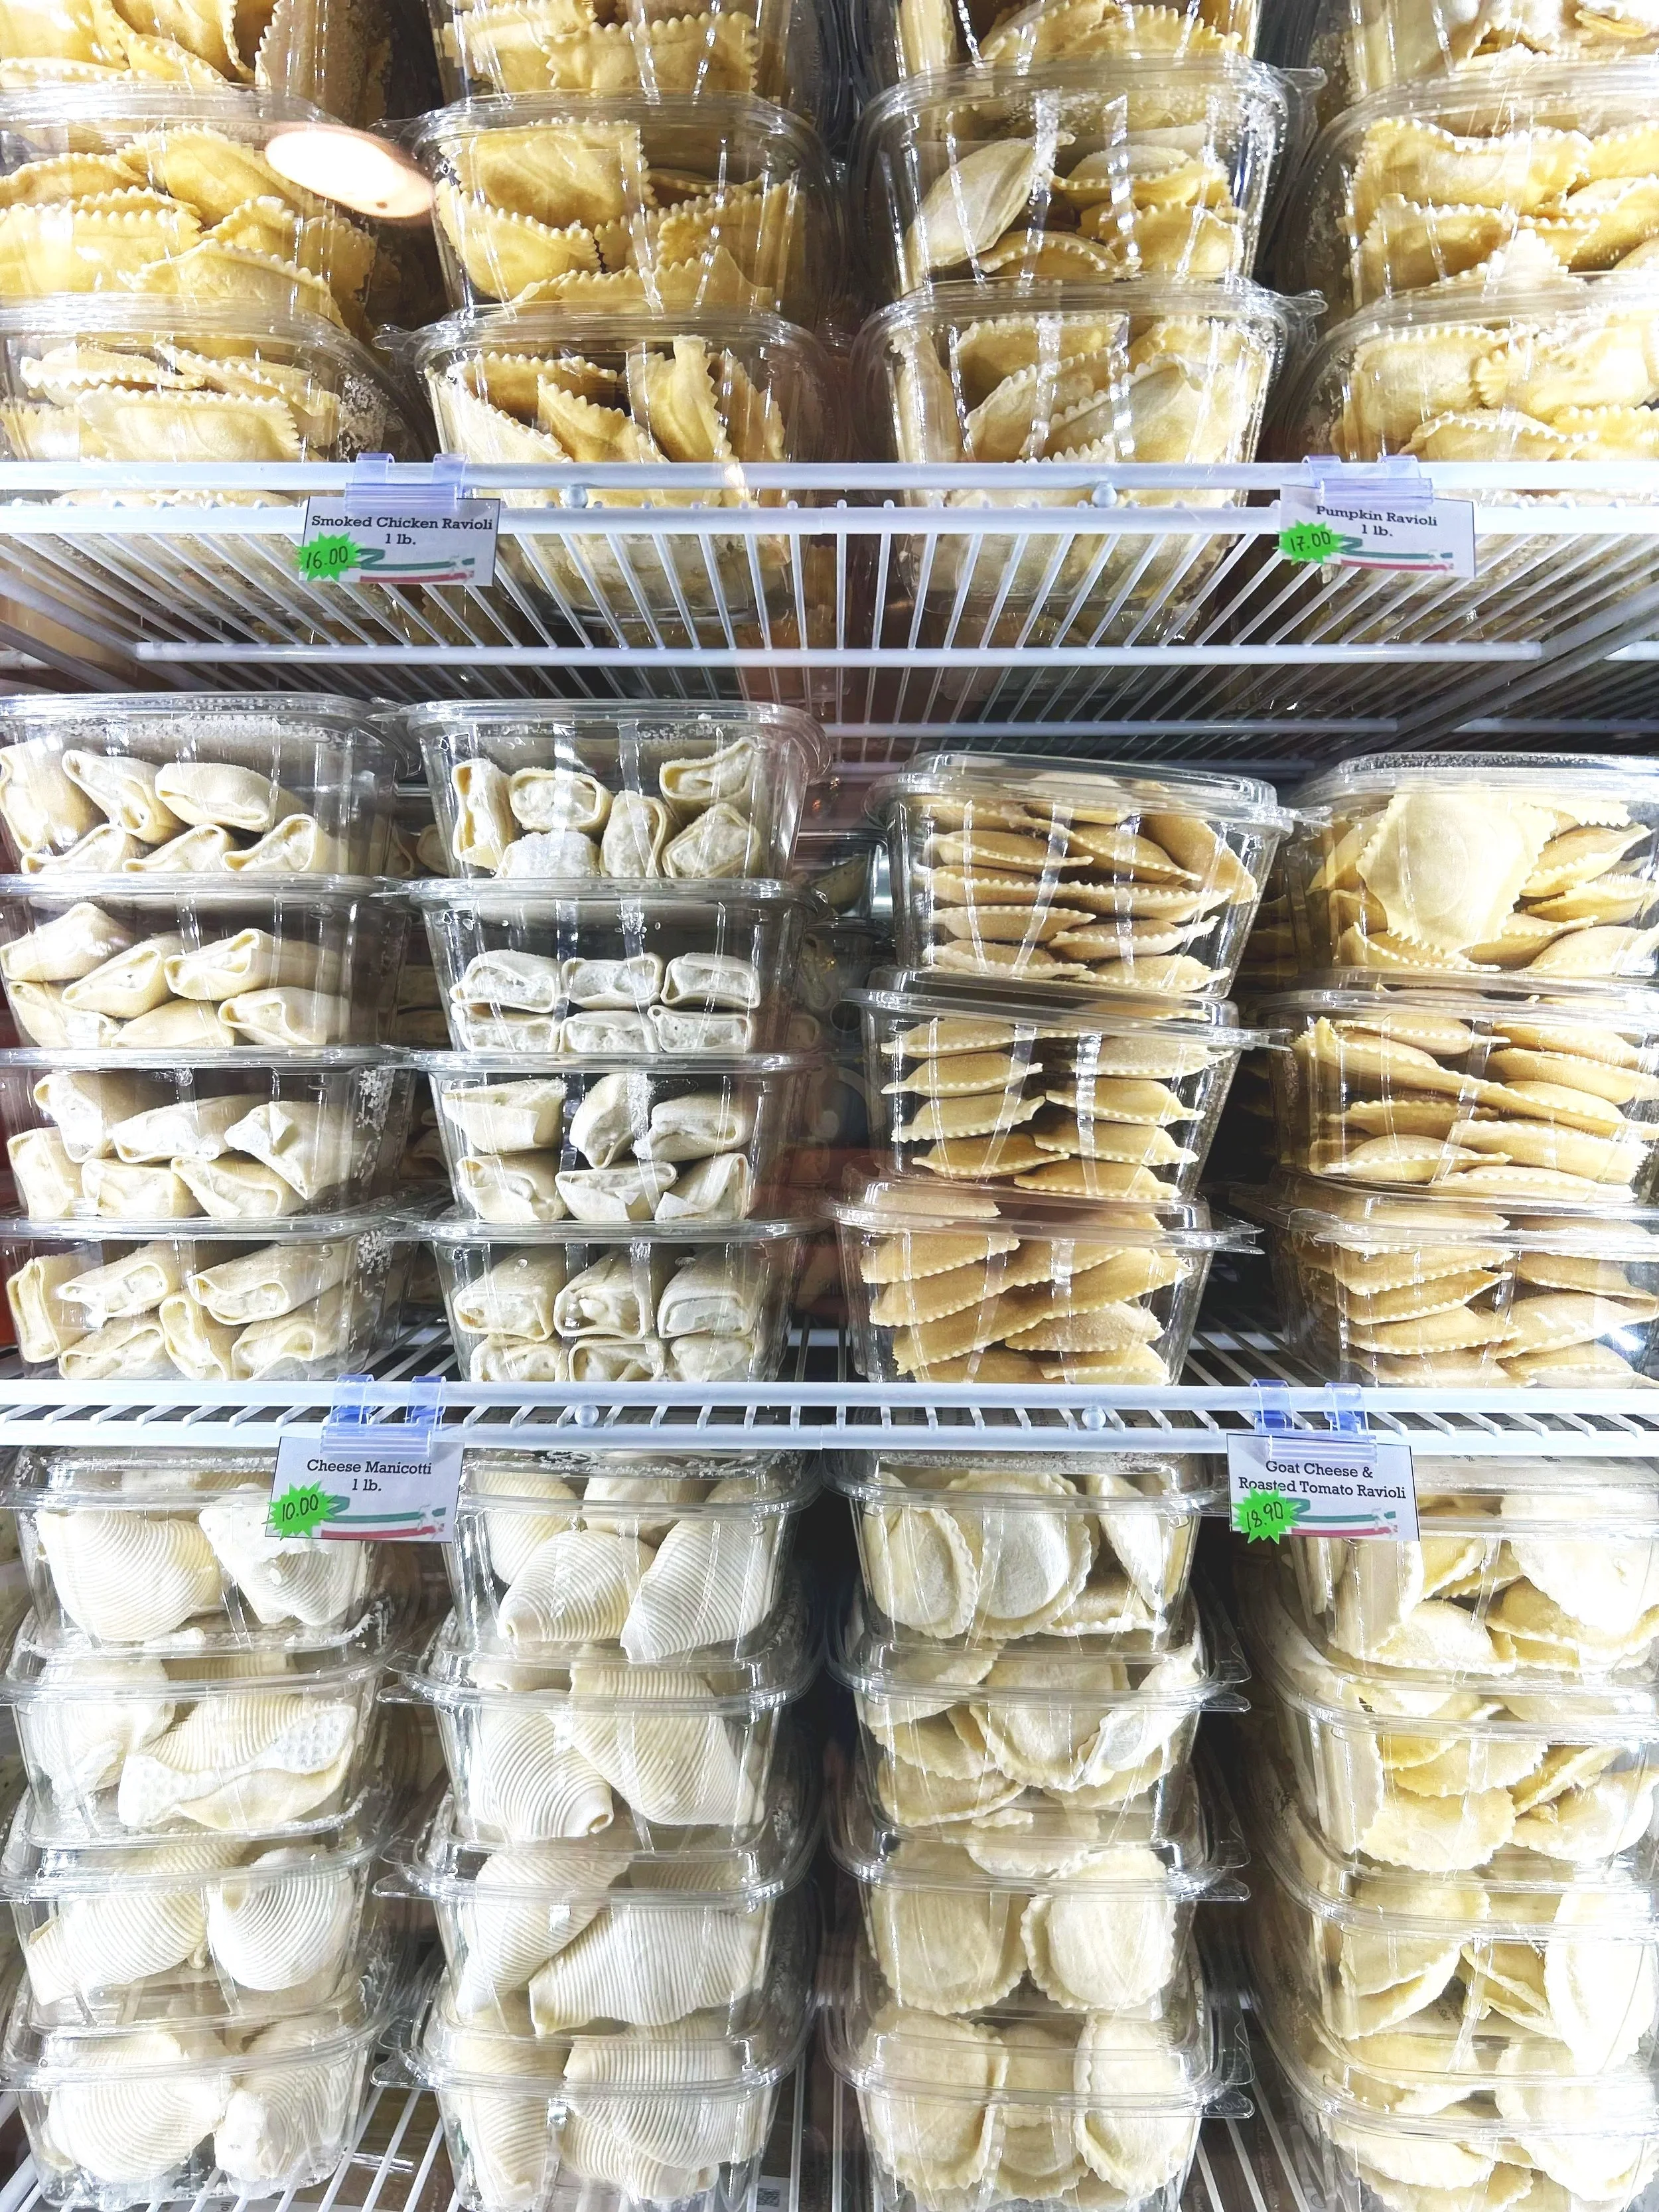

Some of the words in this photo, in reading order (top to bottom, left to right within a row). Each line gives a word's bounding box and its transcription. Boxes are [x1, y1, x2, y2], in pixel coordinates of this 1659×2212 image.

[311, 516, 372, 527] Smoked
[376, 517, 439, 529] Chicken
[443, 518, 493, 530] Ravioli
[1317, 505, 1383, 521] Pumpkin
[1387, 512, 1437, 526] Ravioli
[385, 534, 391, 544] 1
[397, 534, 416, 545] lb.
[1362, 524, 1366, 534] 1
[1373, 525, 1393, 537] lb.
[1290, 531, 1331, 552] 17.00
[305, 546, 348, 569] 16.00
[307, 1459, 362, 1473] Cheese
[365, 1461, 432, 1475] Manicotti
[1265, 1461, 1301, 1474] Goat
[1304, 1463, 1358, 1477] Cheese
[1362, 1466, 1374, 1478] &
[352, 1479, 358, 1491] 1
[364, 1479, 382, 1491] lb.
[1239, 1477, 1296, 1492] Roasted
[1300, 1481, 1353, 1495] Tomato
[1357, 1485, 1406, 1499] Ravioli
[281, 1494, 319, 1522] 10.00
[1246, 1501, 1283, 1530] 18.90
